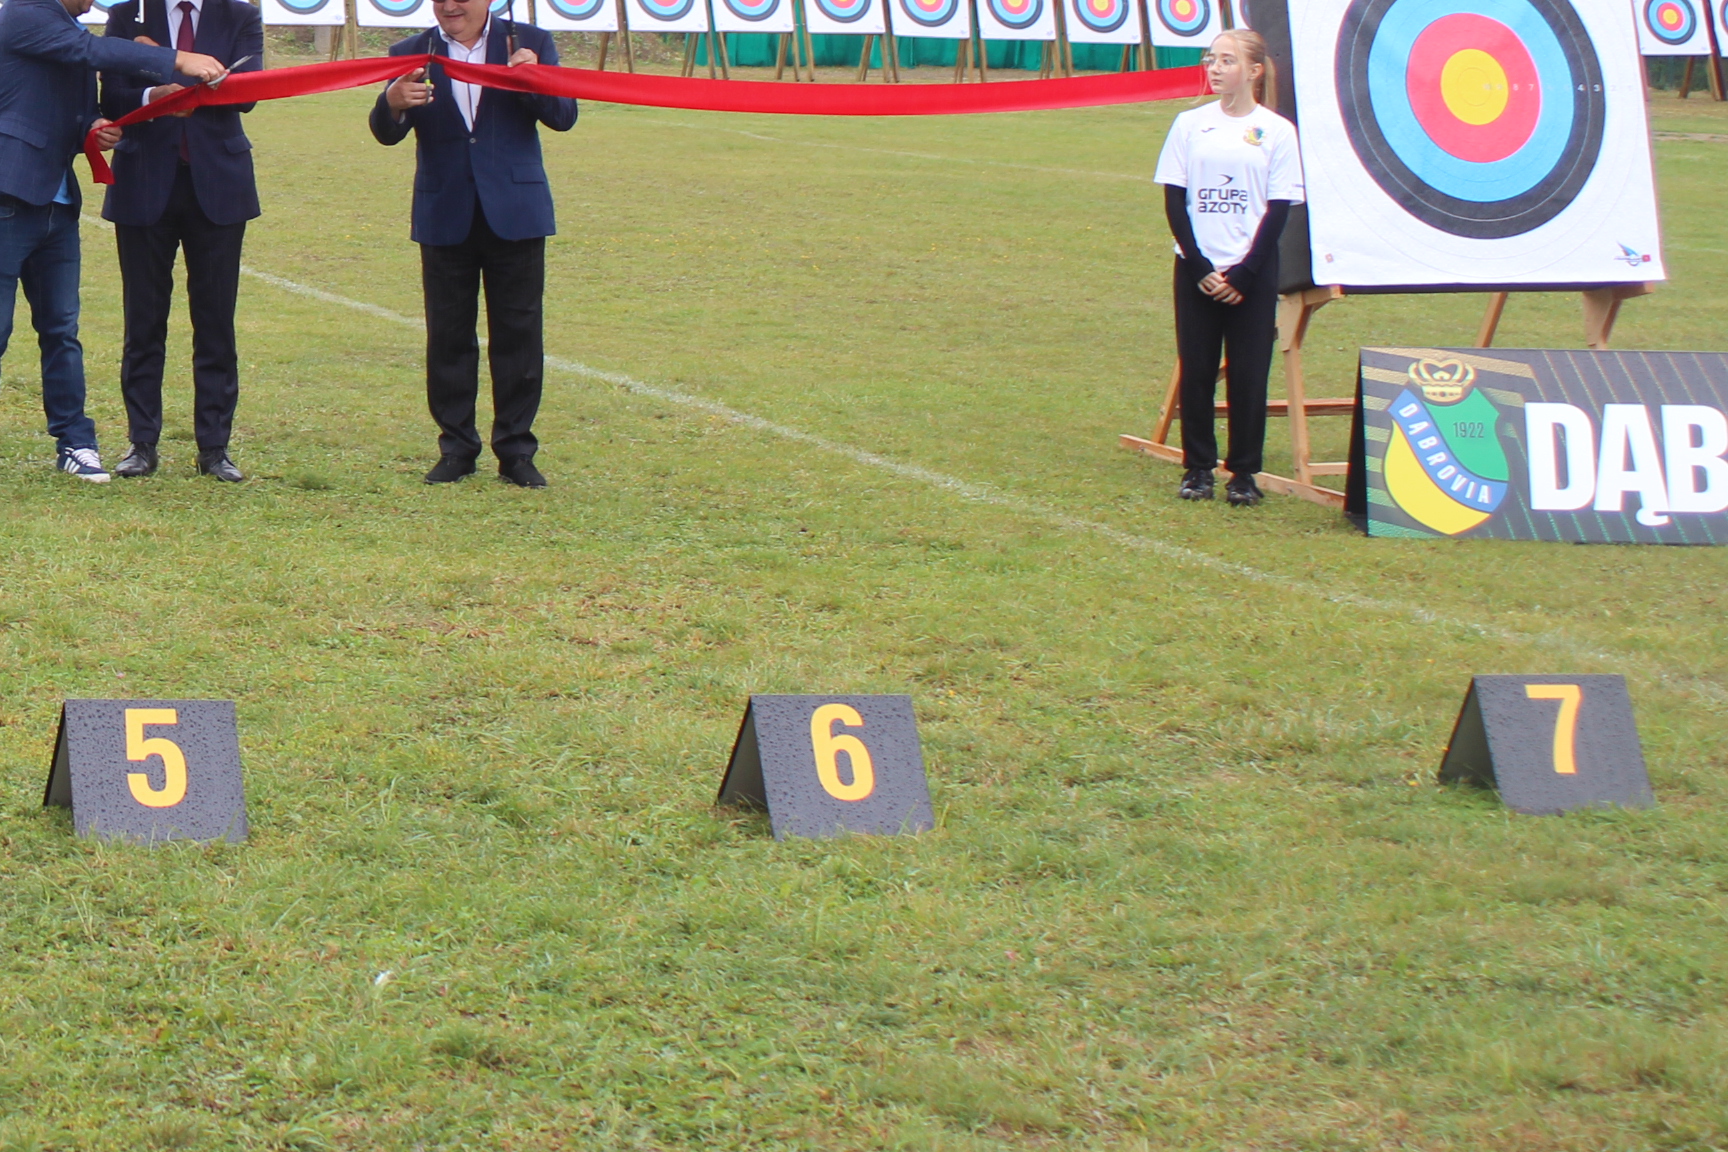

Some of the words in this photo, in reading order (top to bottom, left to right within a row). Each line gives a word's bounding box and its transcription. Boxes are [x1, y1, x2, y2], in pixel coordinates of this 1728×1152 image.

[1594, 84, 1600, 92] 3
[1453, 422, 1484, 438] 1922
[124, 708, 187, 809] 5
[810, 703, 874, 801] 6
[1524, 684, 1582, 774] 7
